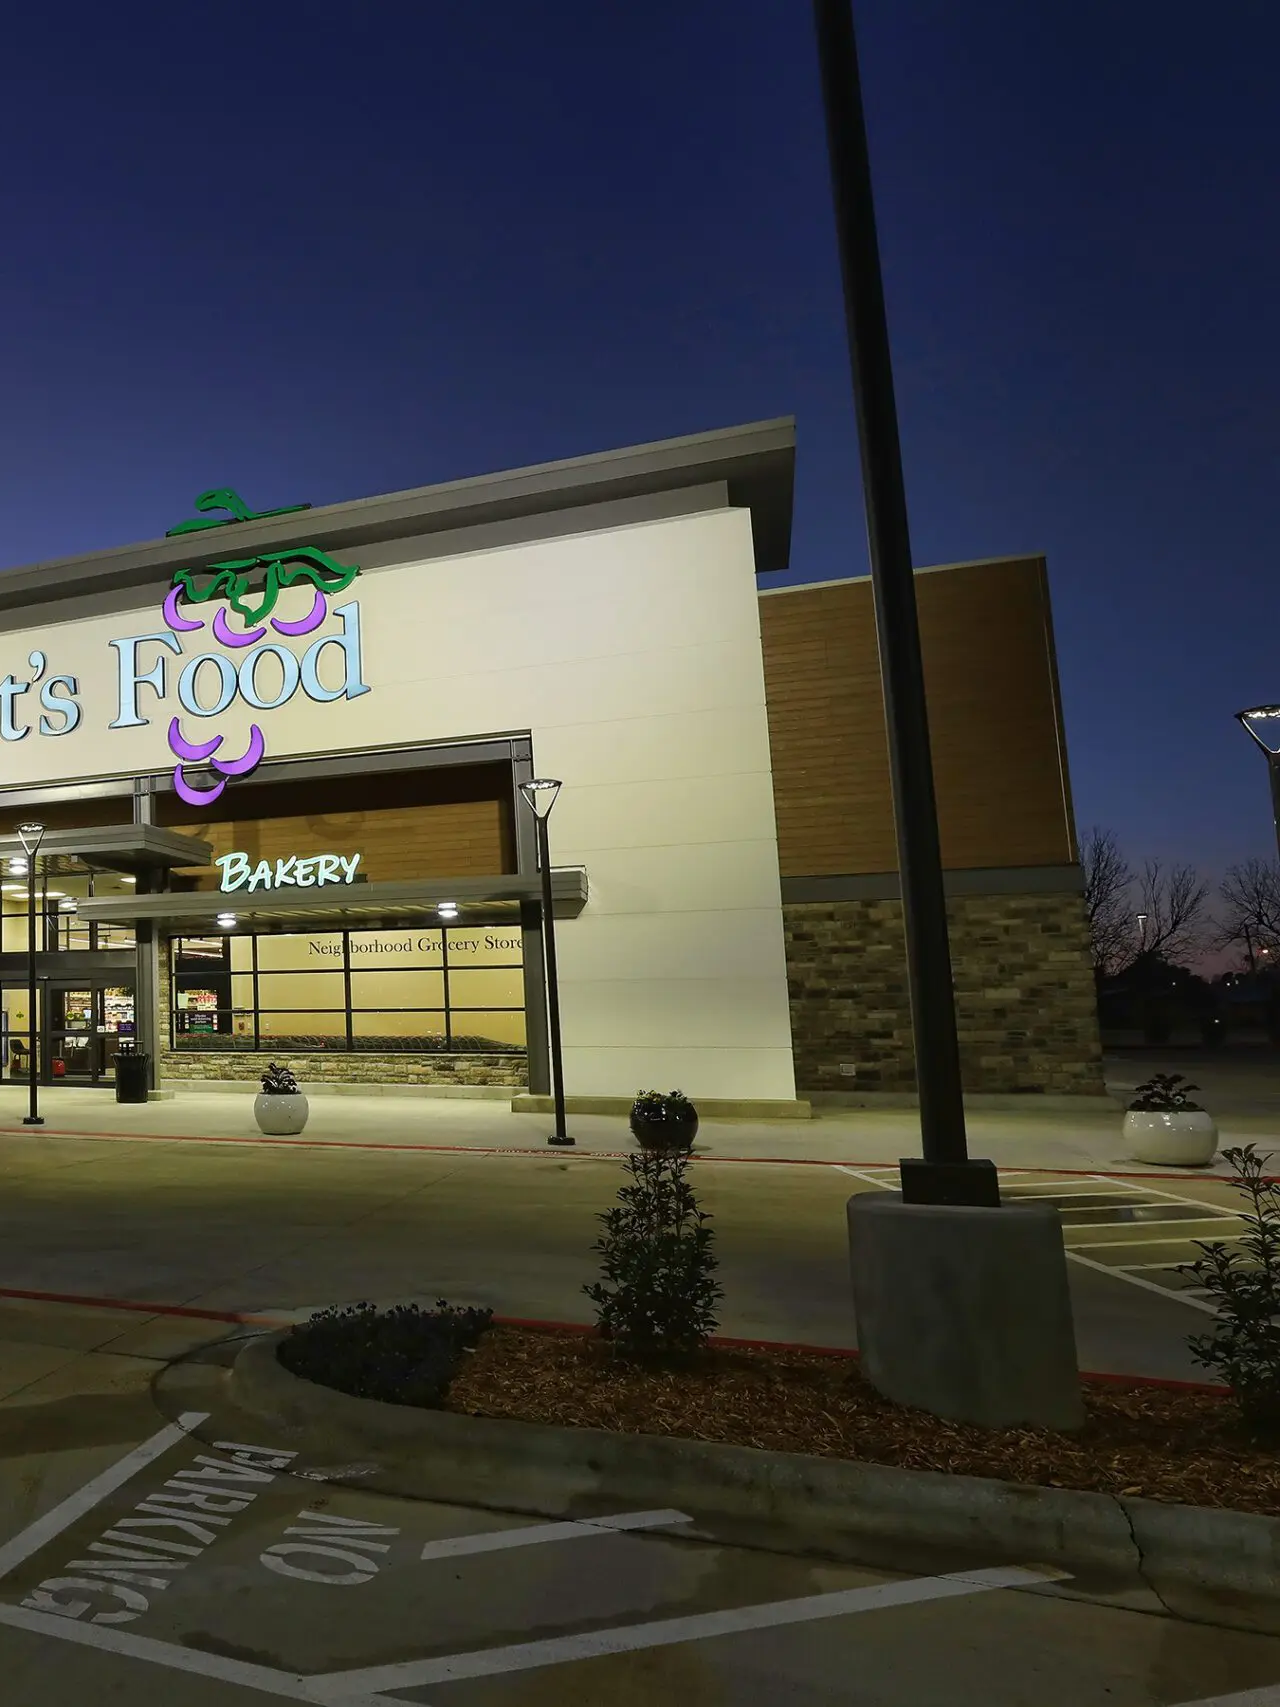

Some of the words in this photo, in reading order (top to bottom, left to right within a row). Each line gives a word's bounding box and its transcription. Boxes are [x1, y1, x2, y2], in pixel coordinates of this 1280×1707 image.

[108, 600, 372, 730] Food
[215, 851, 361, 893] BAKERY
[308, 938, 413, 957] Neigborhood
[21, 1441, 299, 1624] PARKING
[259, 1511, 400, 1585] NO
